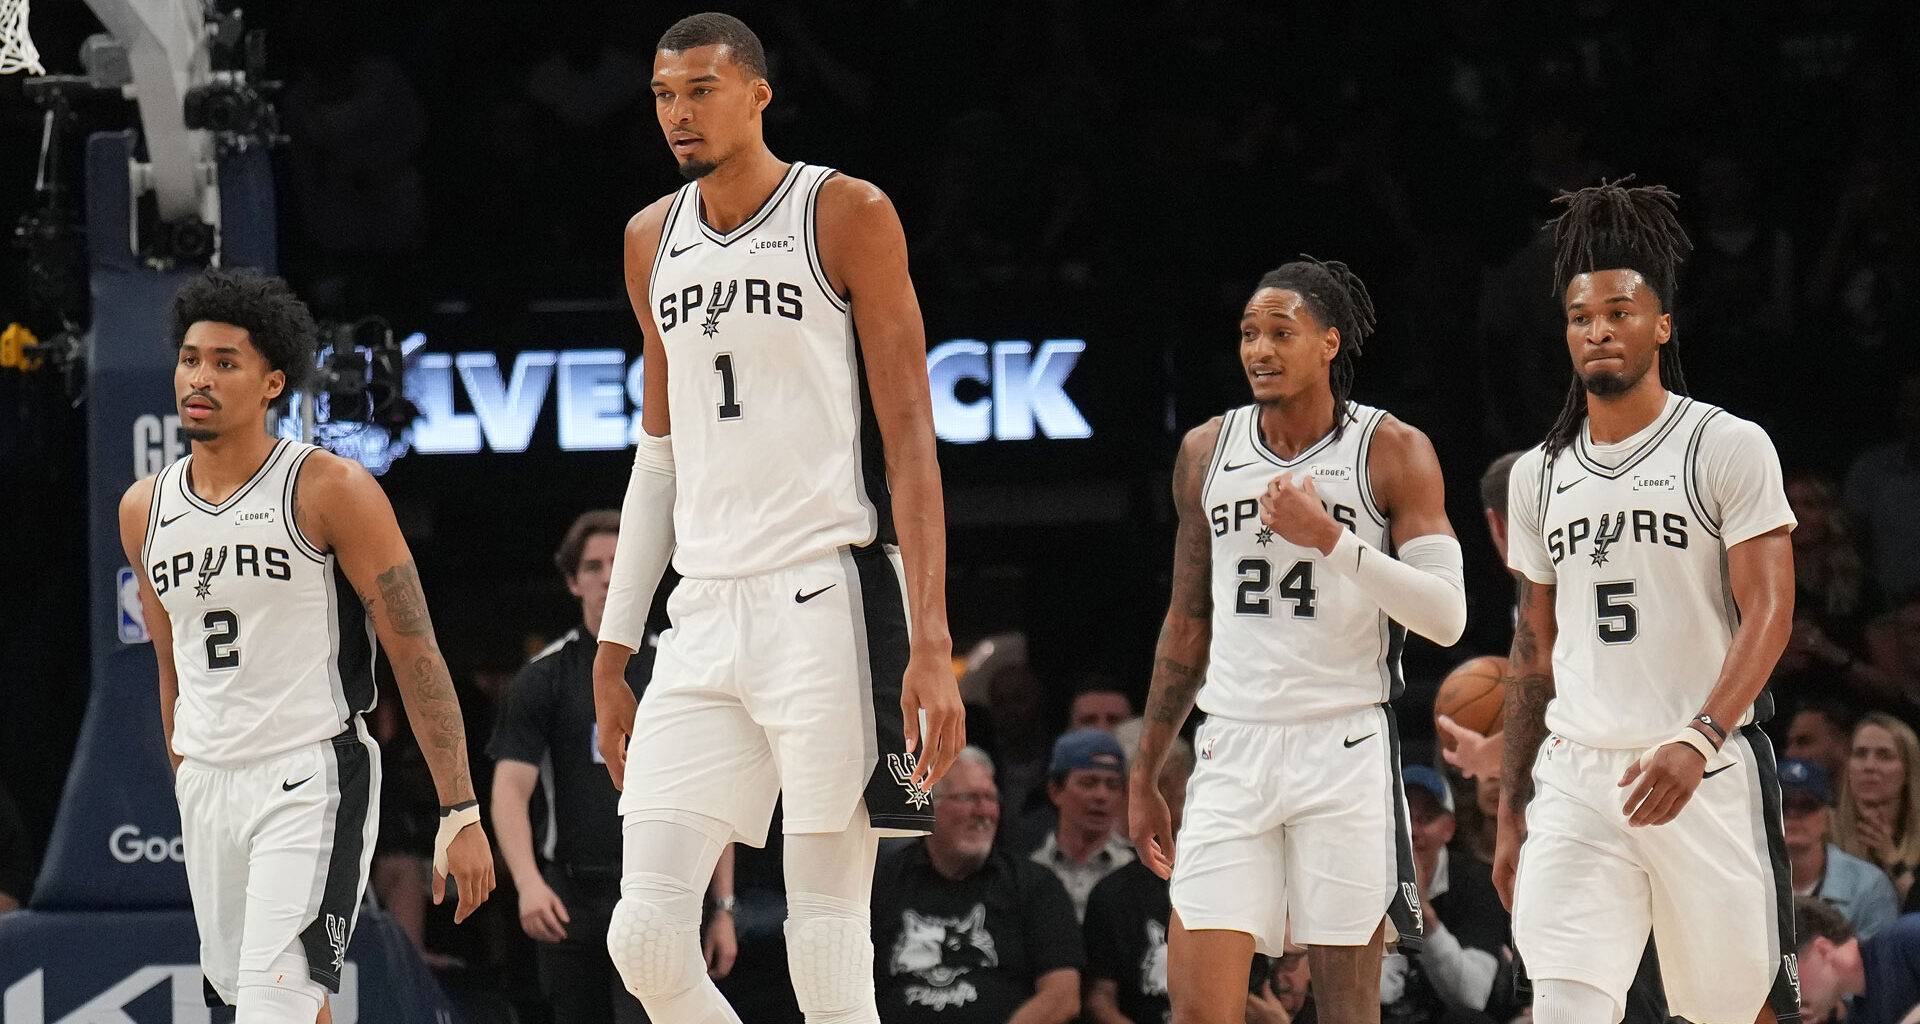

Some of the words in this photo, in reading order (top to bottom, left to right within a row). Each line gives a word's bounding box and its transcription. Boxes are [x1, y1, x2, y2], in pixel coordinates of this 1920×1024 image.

[755, 240, 789, 250] LEDGER
[659, 278, 803, 340] SPURS
[712, 351, 743, 422] 1
[1315, 468, 1346, 477] LEDGER
[1638, 479, 1670, 487] LEDGER
[239, 512, 270, 521] LEDGER
[1211, 498, 1357, 548] SPS
[1547, 509, 1689, 569] SPURS
[152, 544, 292, 601] SPURS
[1234, 556, 1319, 620] 24
[201, 607, 241, 673] 2
[1593, 579, 1640, 646] 5
